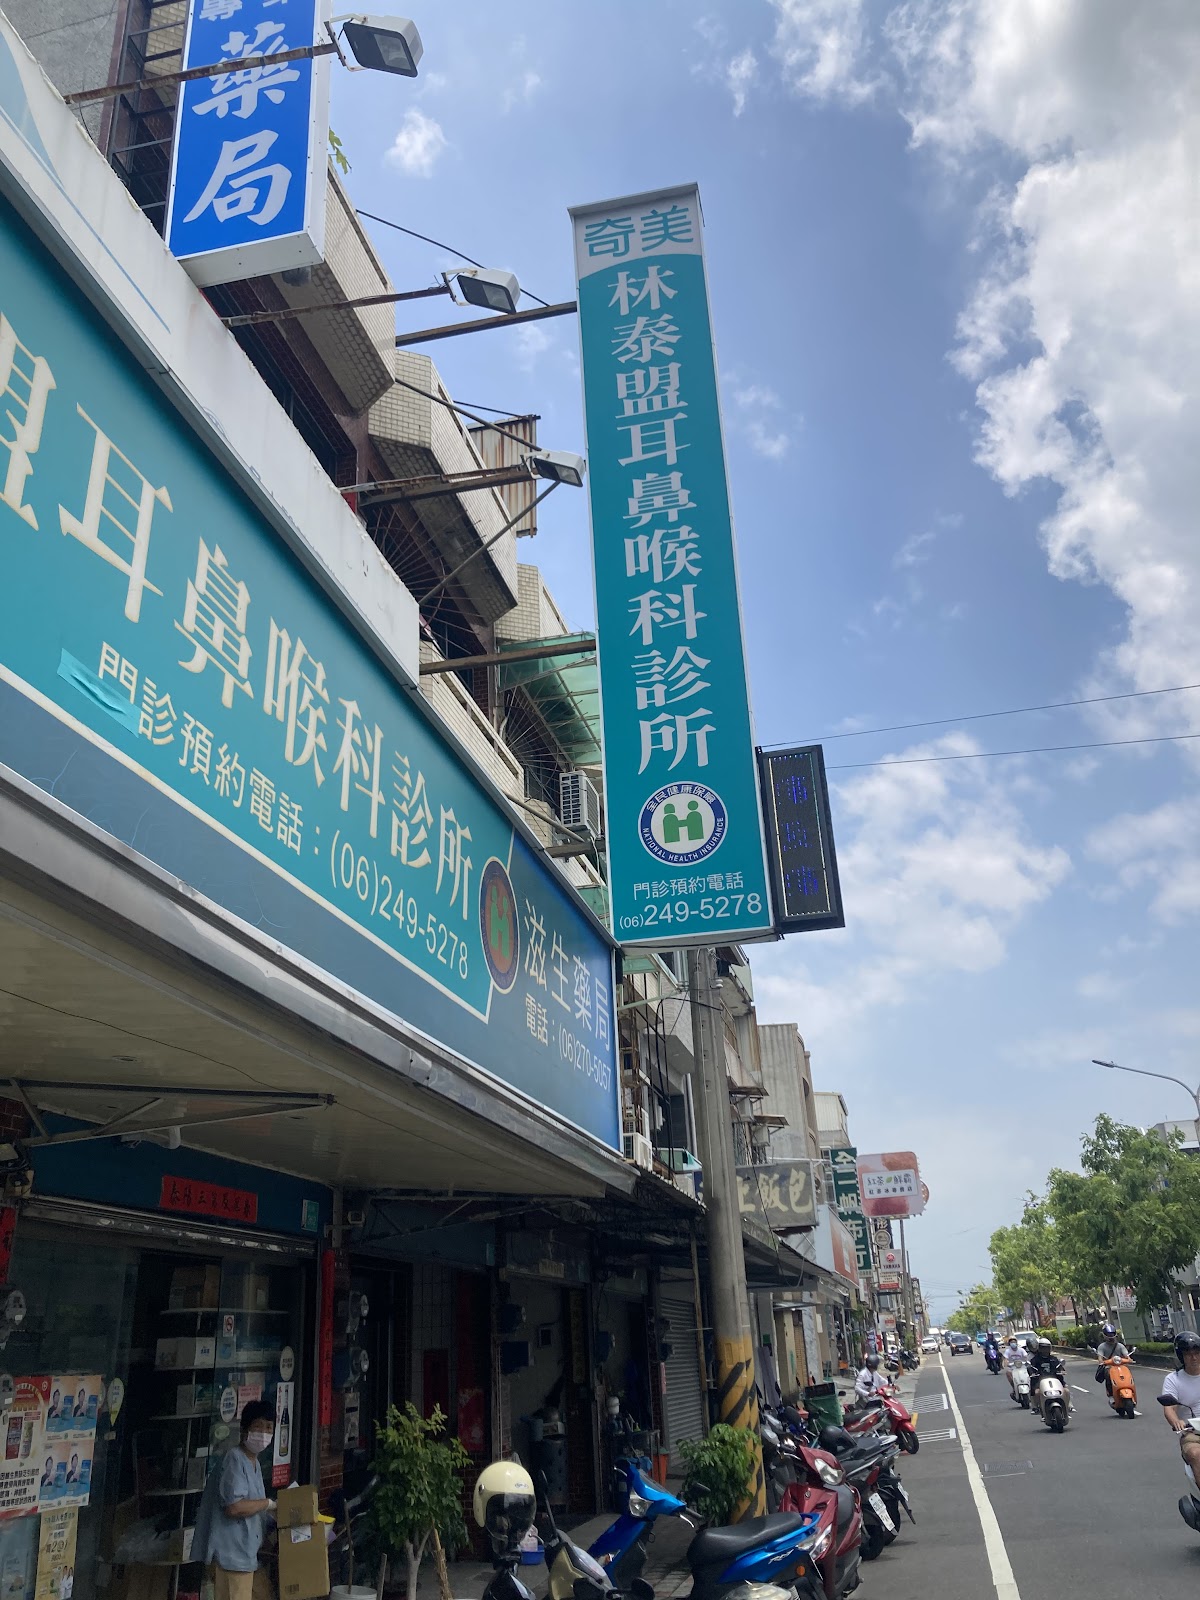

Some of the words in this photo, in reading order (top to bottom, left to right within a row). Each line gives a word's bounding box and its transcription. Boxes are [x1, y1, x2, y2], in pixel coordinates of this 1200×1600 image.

[182, 20, 300, 226] 藥局
[584, 204, 694, 257] 奇美
[608, 264, 717, 775] 林泰盟耳鼻喉科診所
[646, 784, 716, 813] 全民健康保險
[642, 827, 666, 858] NATIONAL
[668, 852, 699, 862] HEALTH
[700, 817, 724, 856] INSURANCE
[329, 827, 470, 980] (06)249-5278
[619, 892, 763, 930] (06)249-5278
[633, 871, 744, 901] 門診預約電話
[523, 896, 611, 1053] 滋生藥局
[698, 1167, 813, 1214] 上飯包
